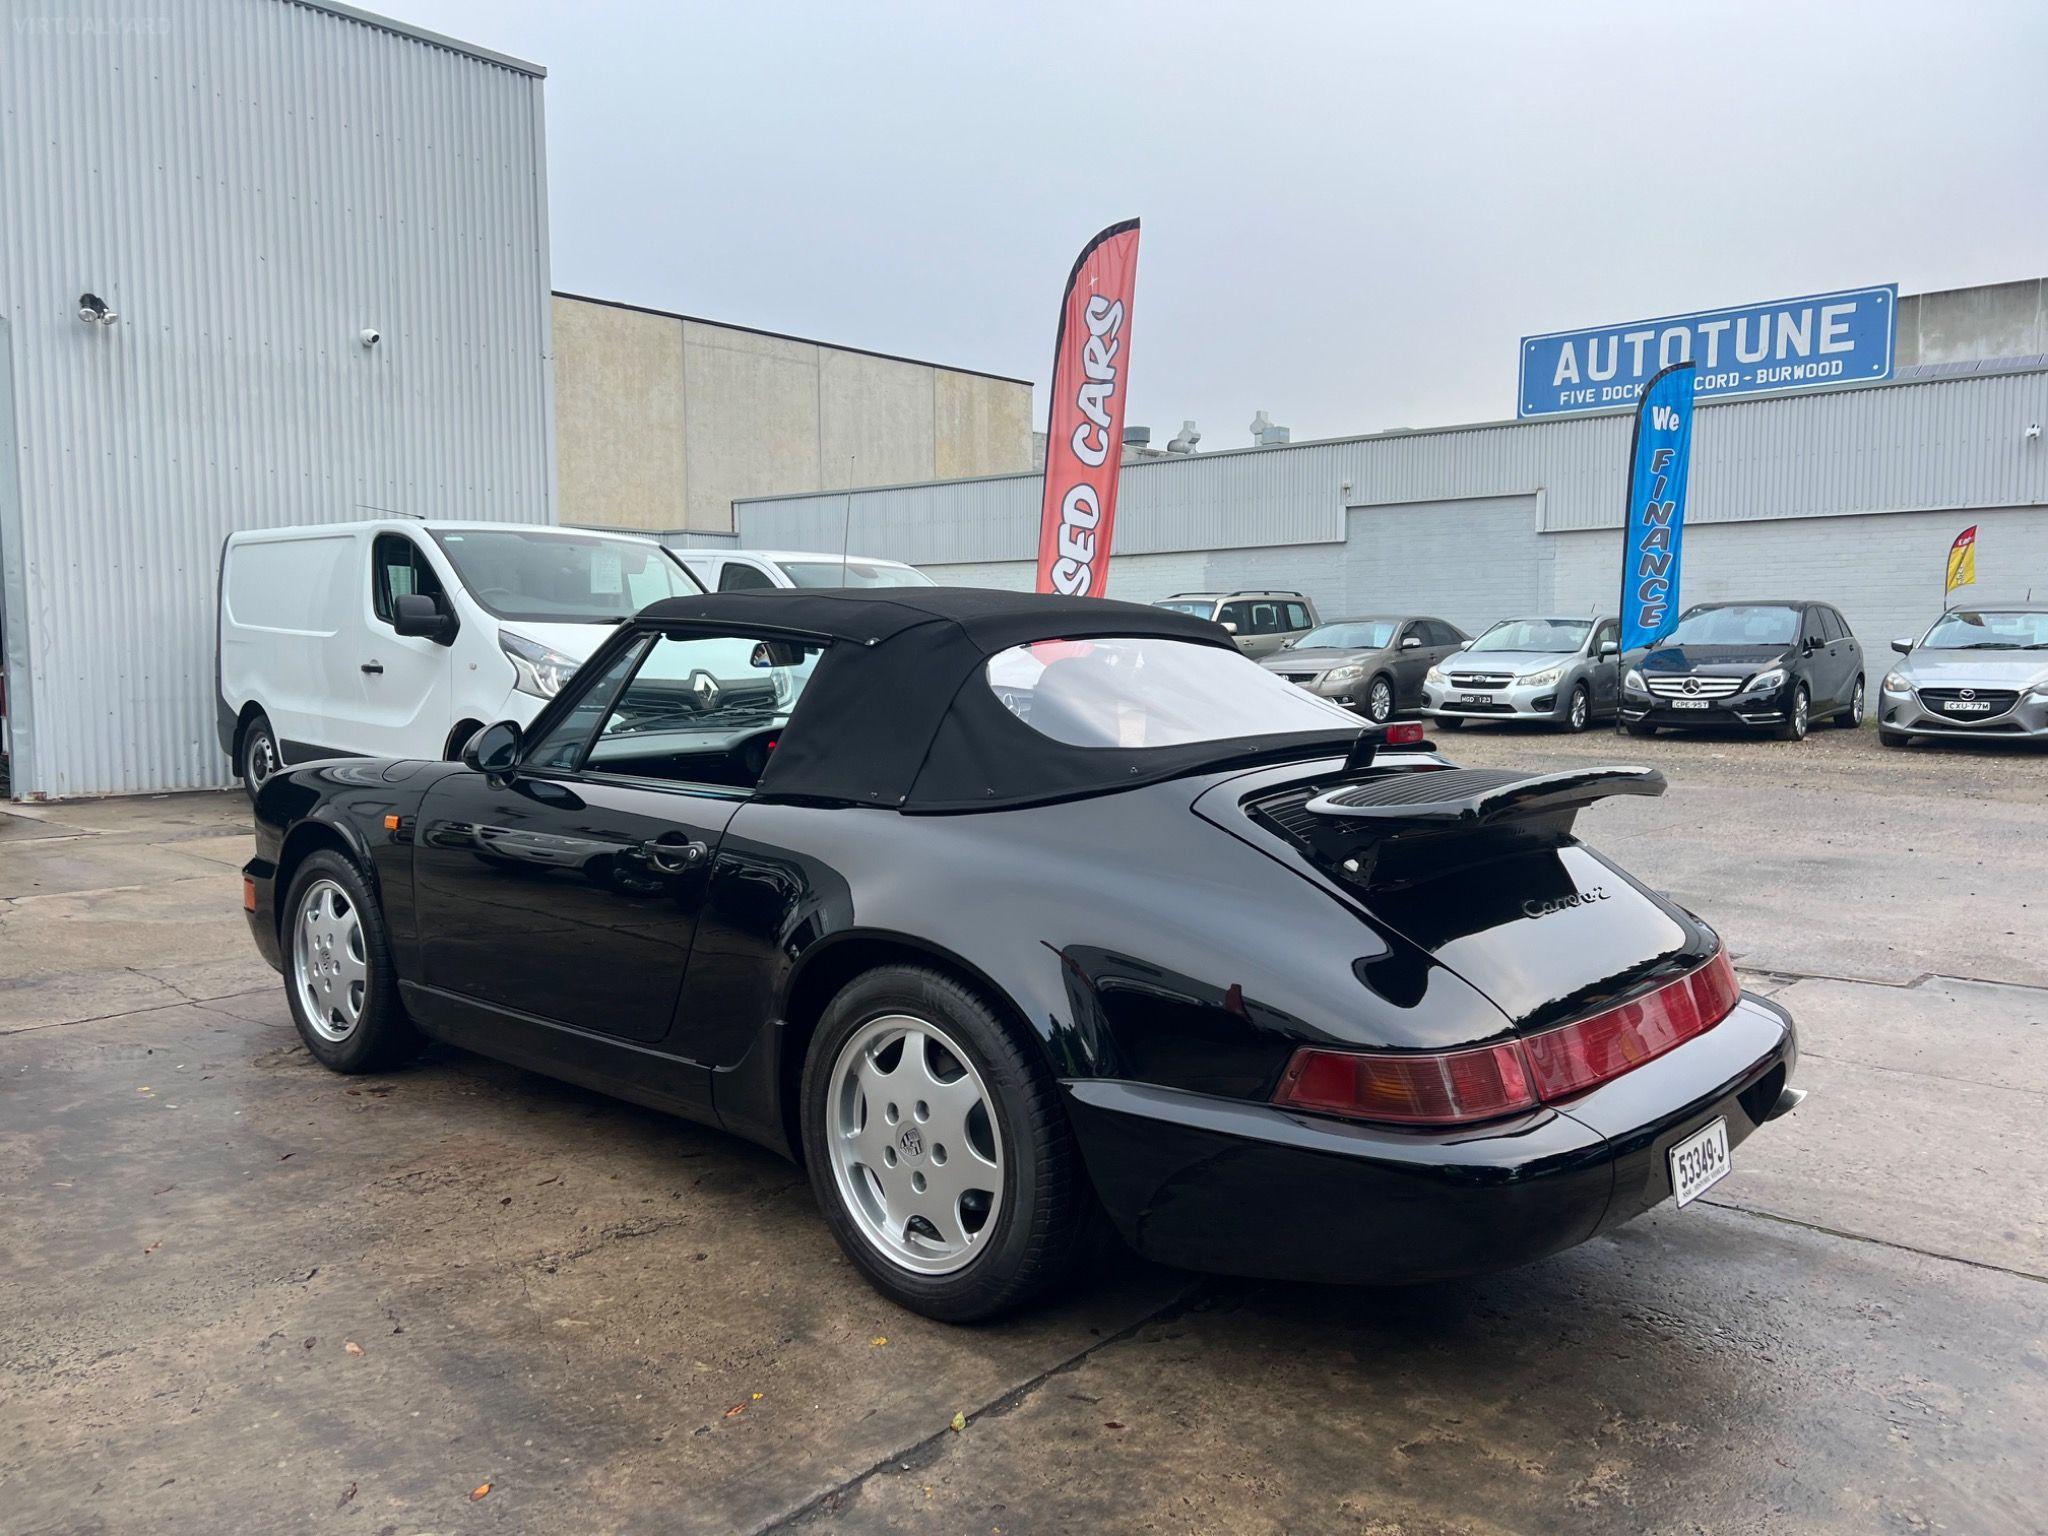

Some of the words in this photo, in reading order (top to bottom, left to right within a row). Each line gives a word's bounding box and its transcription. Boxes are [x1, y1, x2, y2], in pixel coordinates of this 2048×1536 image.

[1070, 293, 1125, 469] CARS
[1552, 301, 1857, 387] AUTOTUNE
[1559, 387, 1596, 406] FIVE
[1602, 383, 1643, 402] DOCK
[1755, 359, 1844, 385] BURWOOD
[1652, 405, 1680, 432] We
[1051, 482, 1102, 597] SED
[1638, 448, 1675, 630] FINANCE
